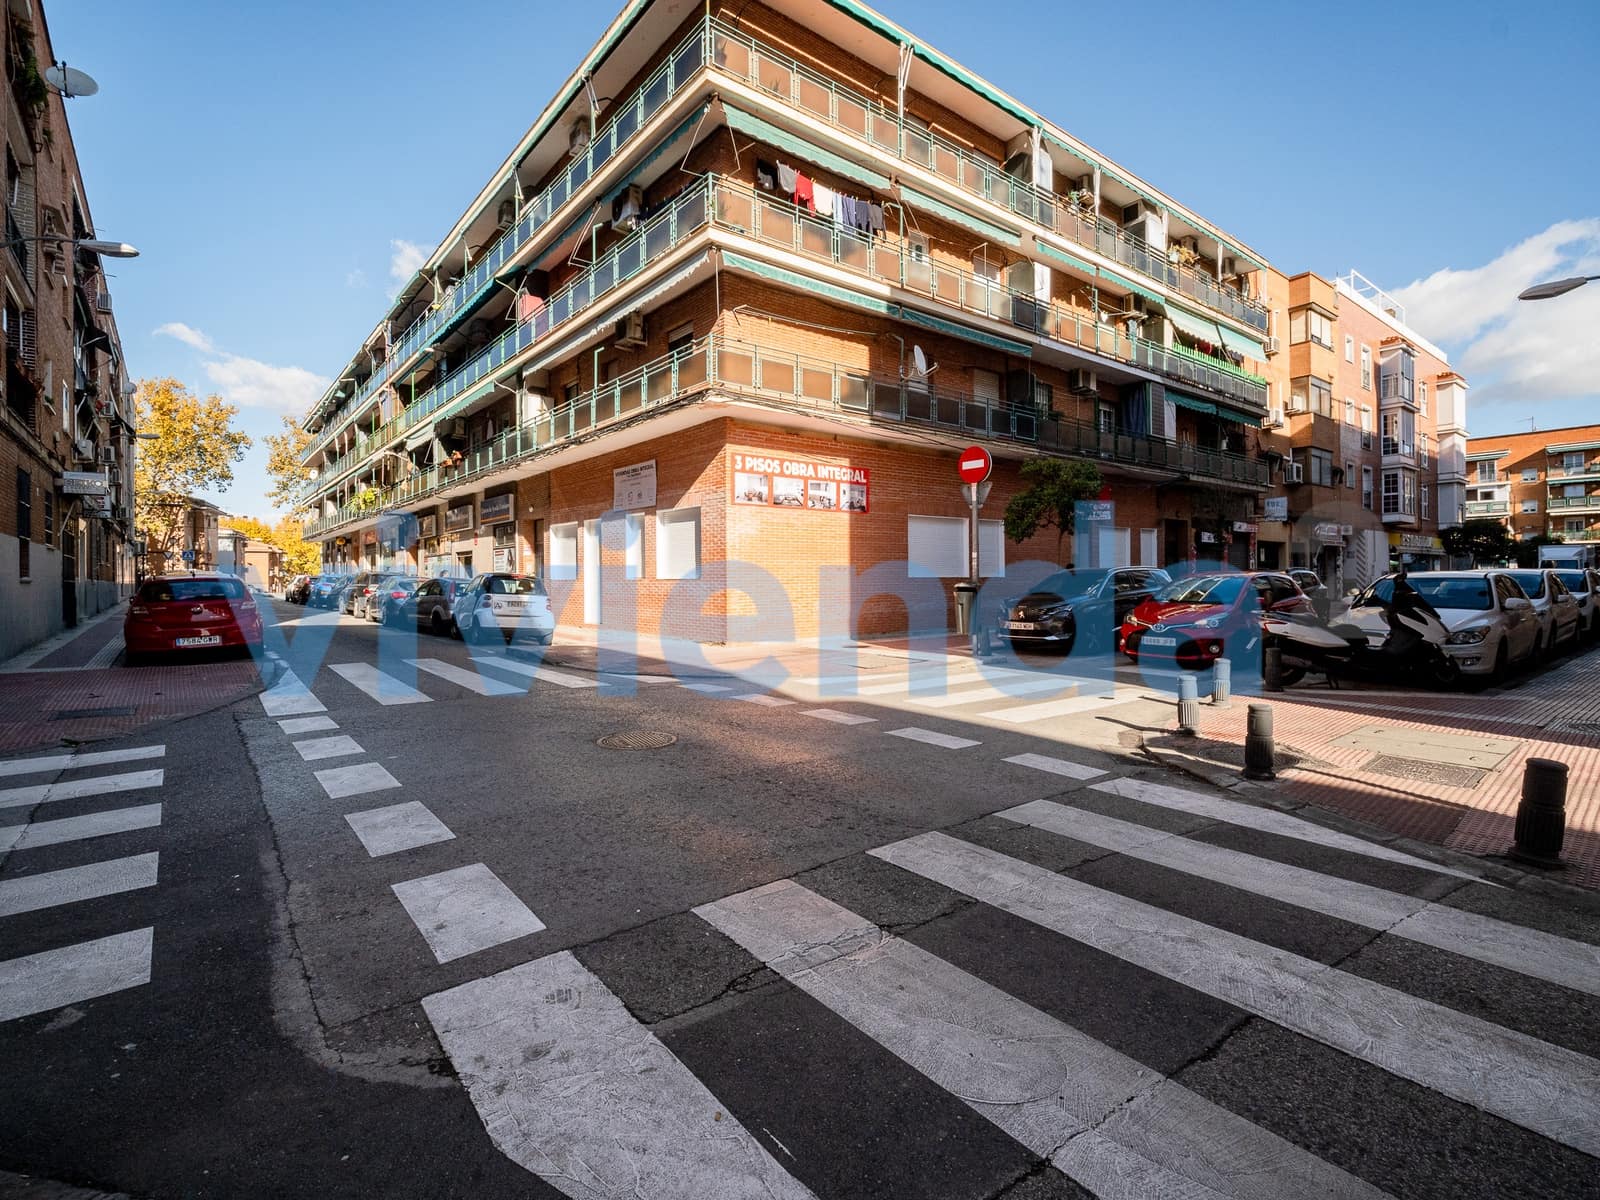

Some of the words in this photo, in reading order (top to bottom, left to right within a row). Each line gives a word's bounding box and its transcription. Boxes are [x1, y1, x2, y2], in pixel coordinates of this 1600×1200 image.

[734, 455, 744, 470] 3
[745, 456, 781, 474] PISOS
[783, 460, 815, 478] OBRA
[817, 464, 867, 483] INTEGRAL
